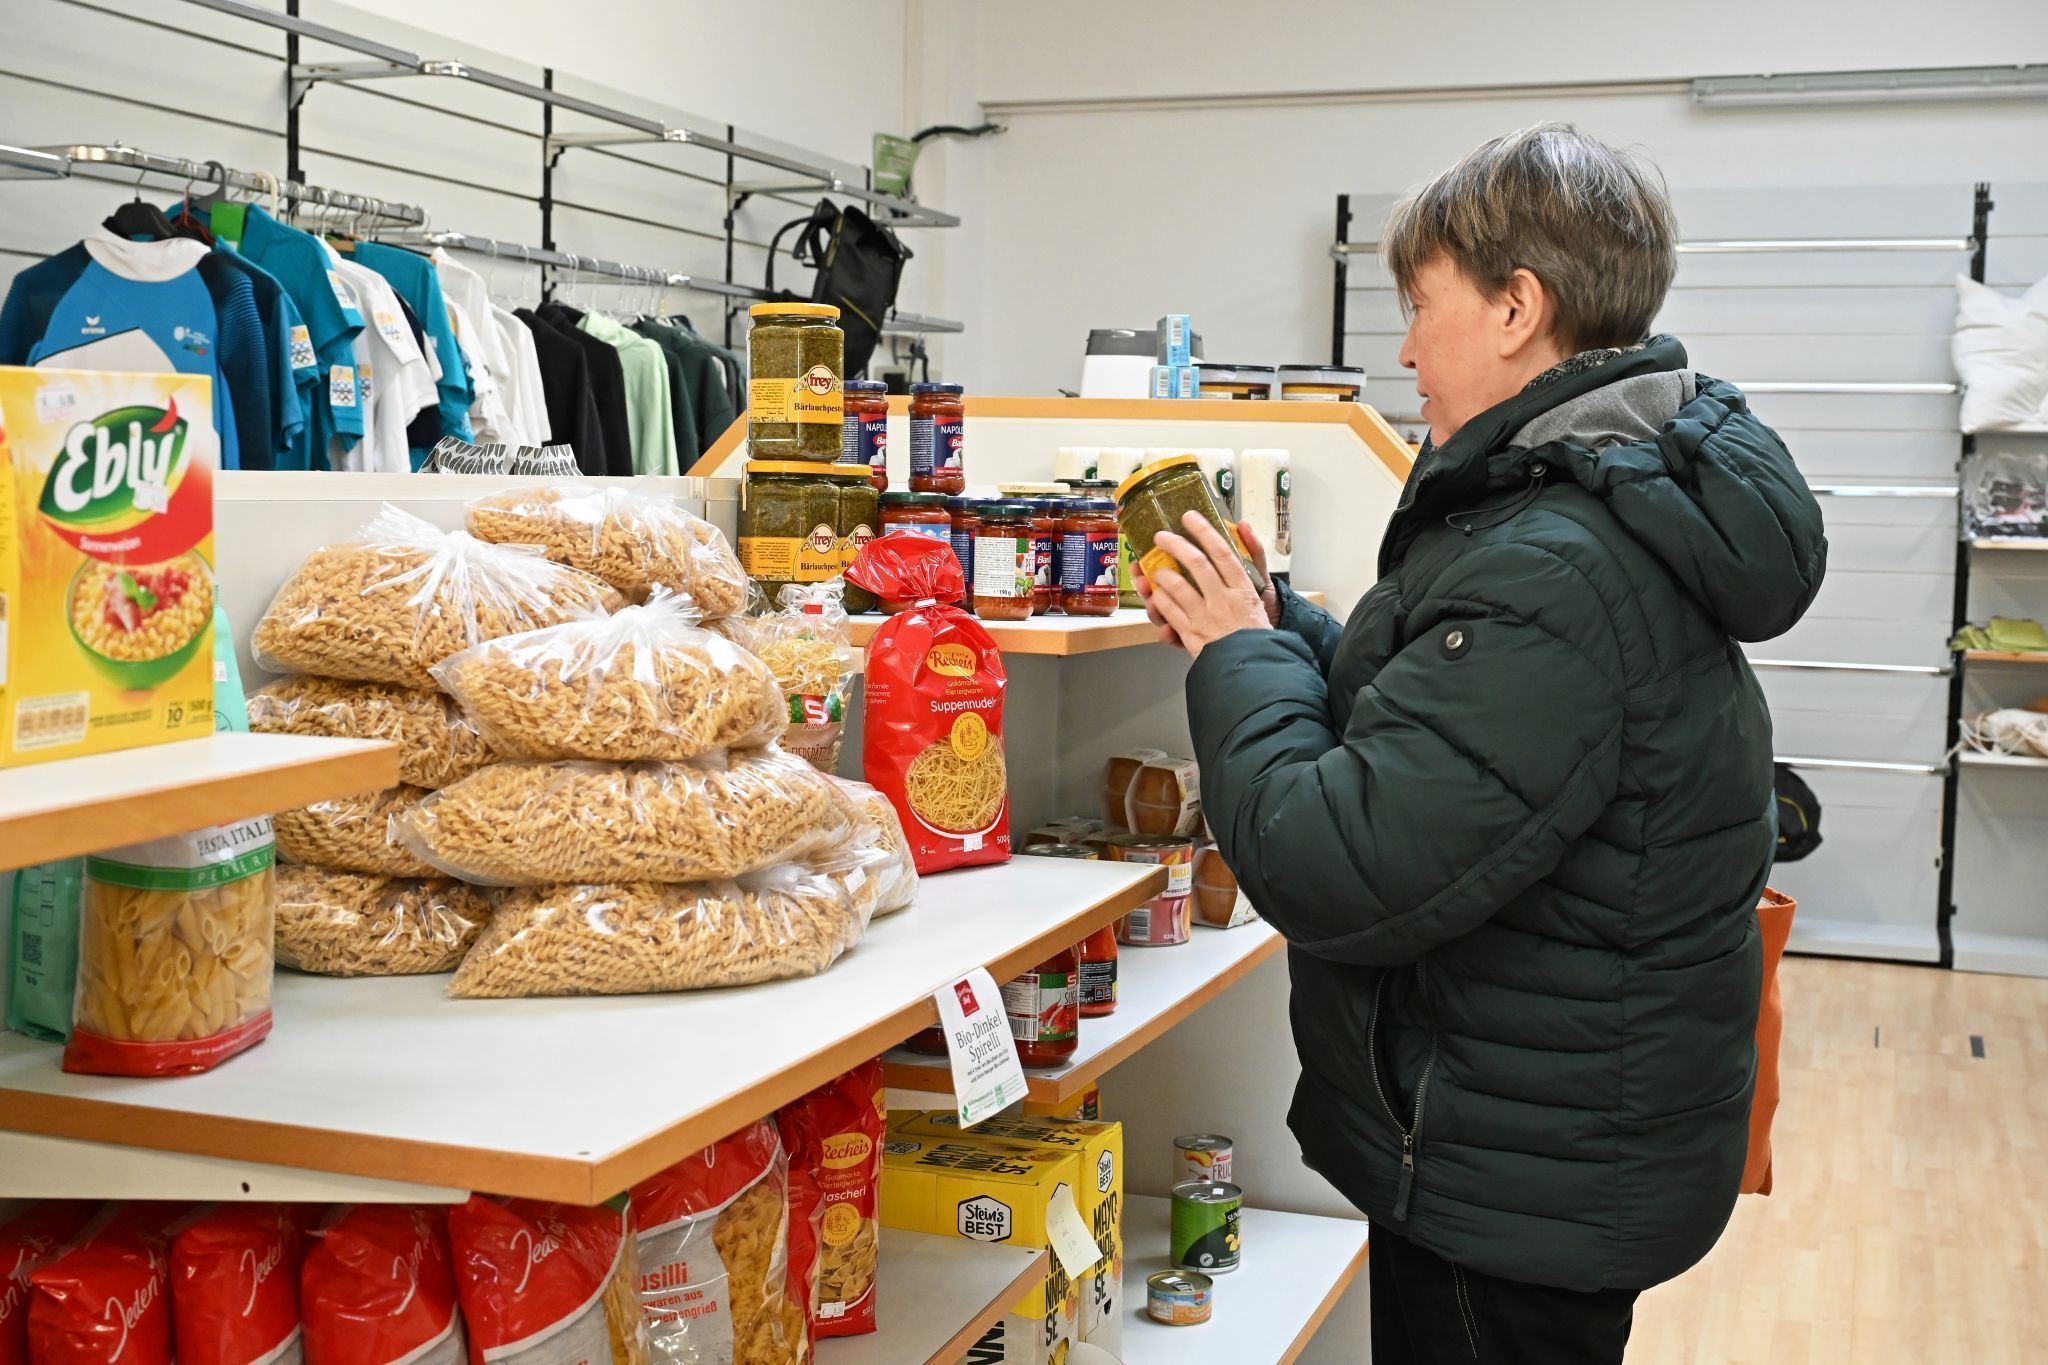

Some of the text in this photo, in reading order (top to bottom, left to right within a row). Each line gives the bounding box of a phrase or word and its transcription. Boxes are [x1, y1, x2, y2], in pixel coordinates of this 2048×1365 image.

[809, 373, 832, 389] frey
[54, 420, 175, 512] Ebly
[814, 532, 833, 548] frey
[930, 651, 973, 670] Recheis
[168, 707, 183, 723] 10
[196, 834, 231, 857] PASTA
[920, 846, 927, 855] 5
[198, 858, 248, 884] PENNE
[955, 1010, 1002, 1049] Bio-Dinkel
[968, 1032, 1001, 1063] Spirelli
[1098, 1169, 1112, 1188] BEST
[965, 1203, 1005, 1222] Stein's
[965, 1220, 1005, 1237] BEST
[642, 1289, 703, 1314] gwaren aus
